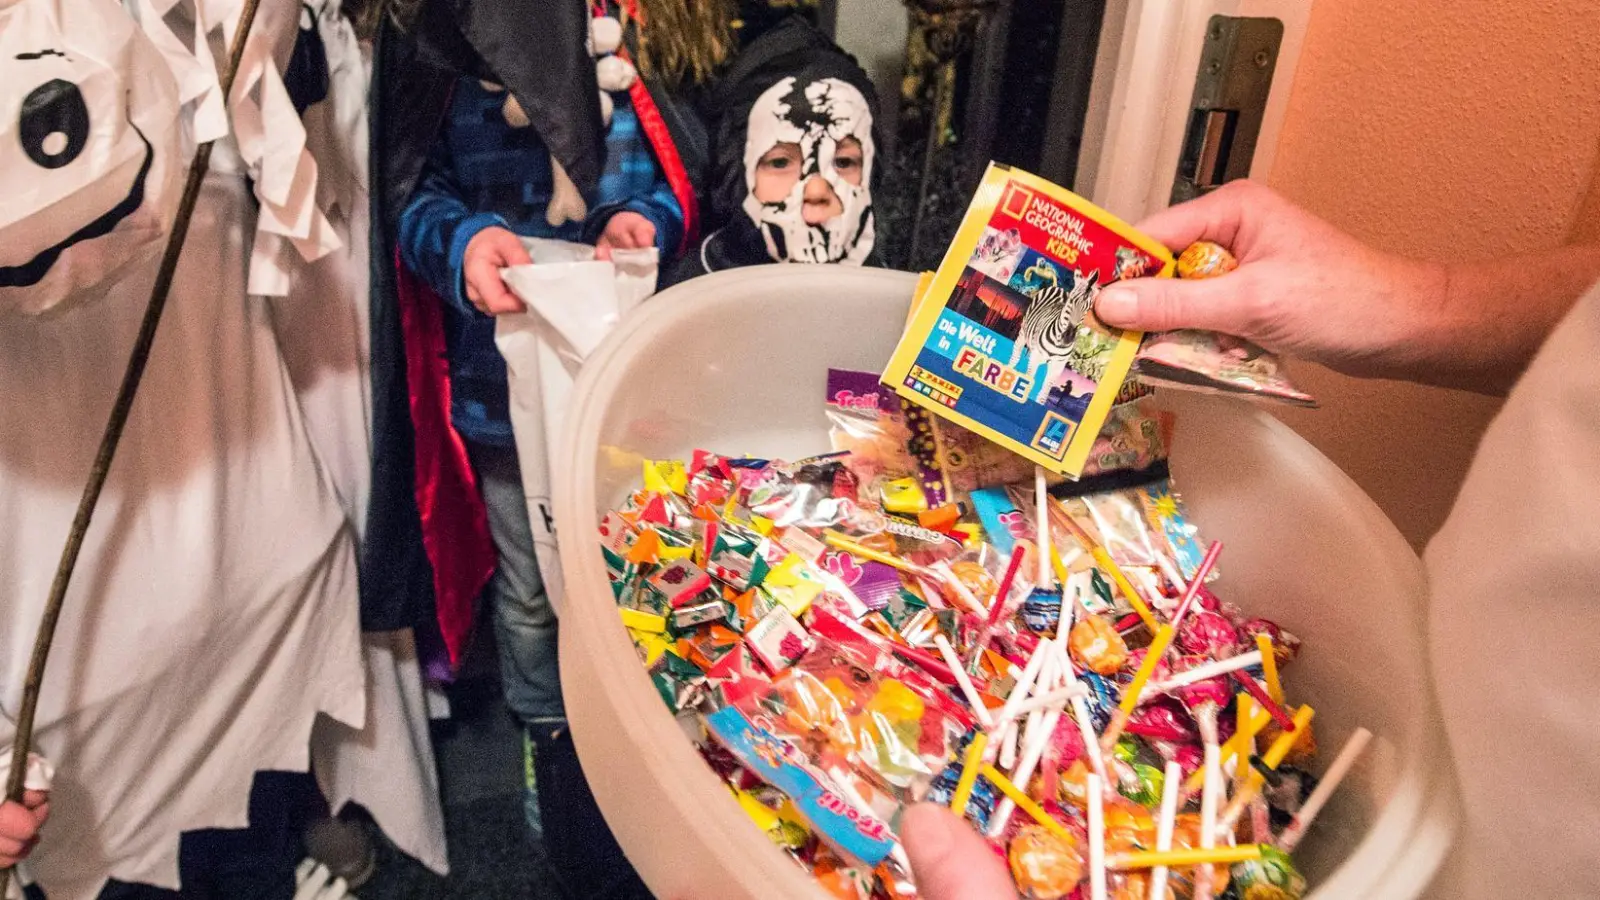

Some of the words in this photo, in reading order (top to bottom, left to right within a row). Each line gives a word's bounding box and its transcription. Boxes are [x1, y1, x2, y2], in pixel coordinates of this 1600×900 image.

[1025, 210, 1093, 256] GEOGRAPHIC
[1032, 197, 1085, 235] NATIONAL
[938, 318, 958, 336] Die
[958, 321, 997, 355] Welt
[938, 335, 951, 351] in
[956, 348, 1031, 400] FARBE
[816, 792, 885, 842] Trolli
